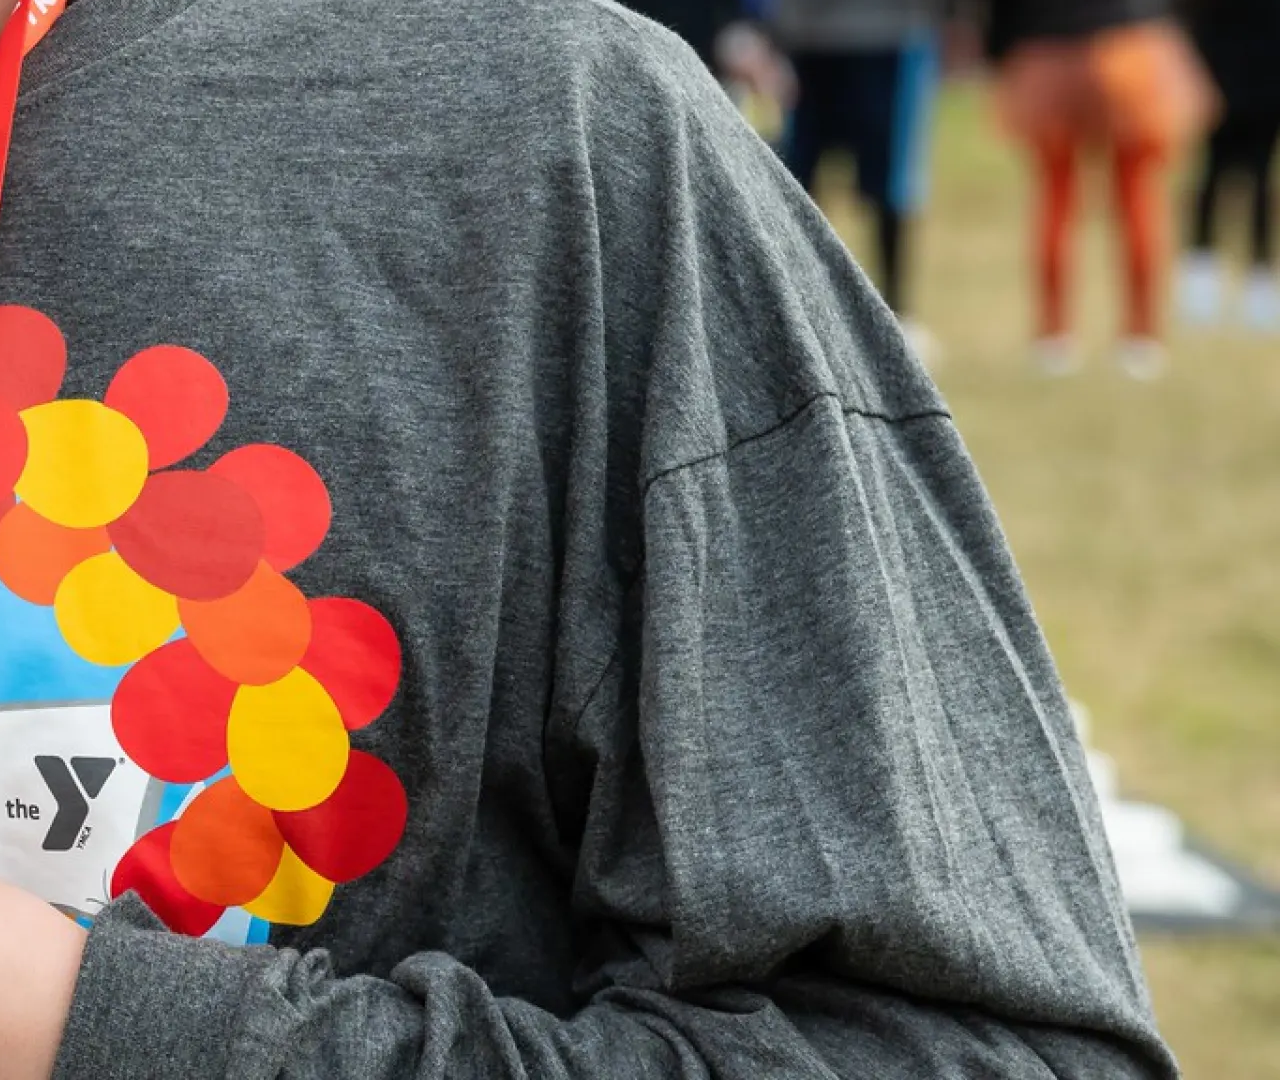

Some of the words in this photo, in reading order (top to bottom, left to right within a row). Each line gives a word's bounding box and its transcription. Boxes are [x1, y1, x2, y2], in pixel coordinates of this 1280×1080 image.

[5, 798, 40, 820] the
[33, 755, 117, 852] Y
[76, 825, 92, 849] YMCA
